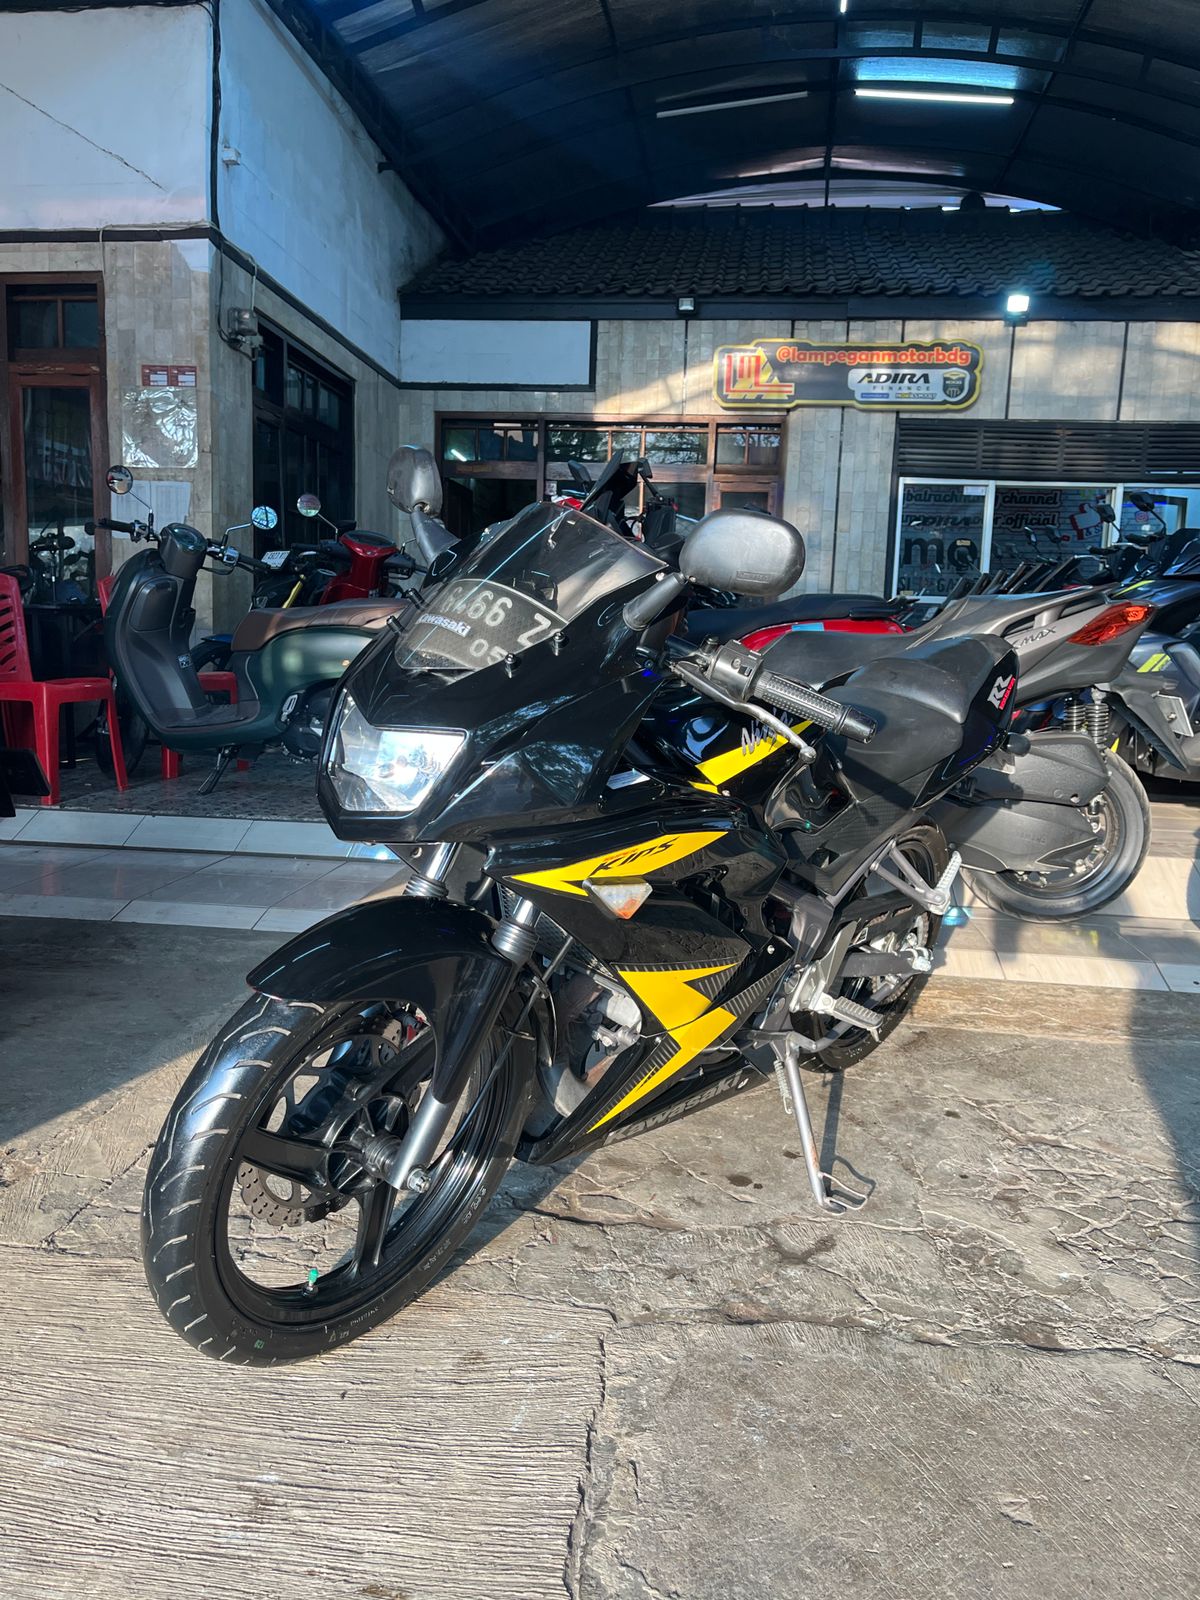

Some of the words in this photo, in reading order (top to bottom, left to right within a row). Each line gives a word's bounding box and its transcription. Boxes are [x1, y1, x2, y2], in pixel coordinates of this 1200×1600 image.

[776, 346, 972, 366] @lampeganmotorbdg
[857, 372, 931, 384] ADIRA
[603, 1070, 743, 1146] Kawasaki
